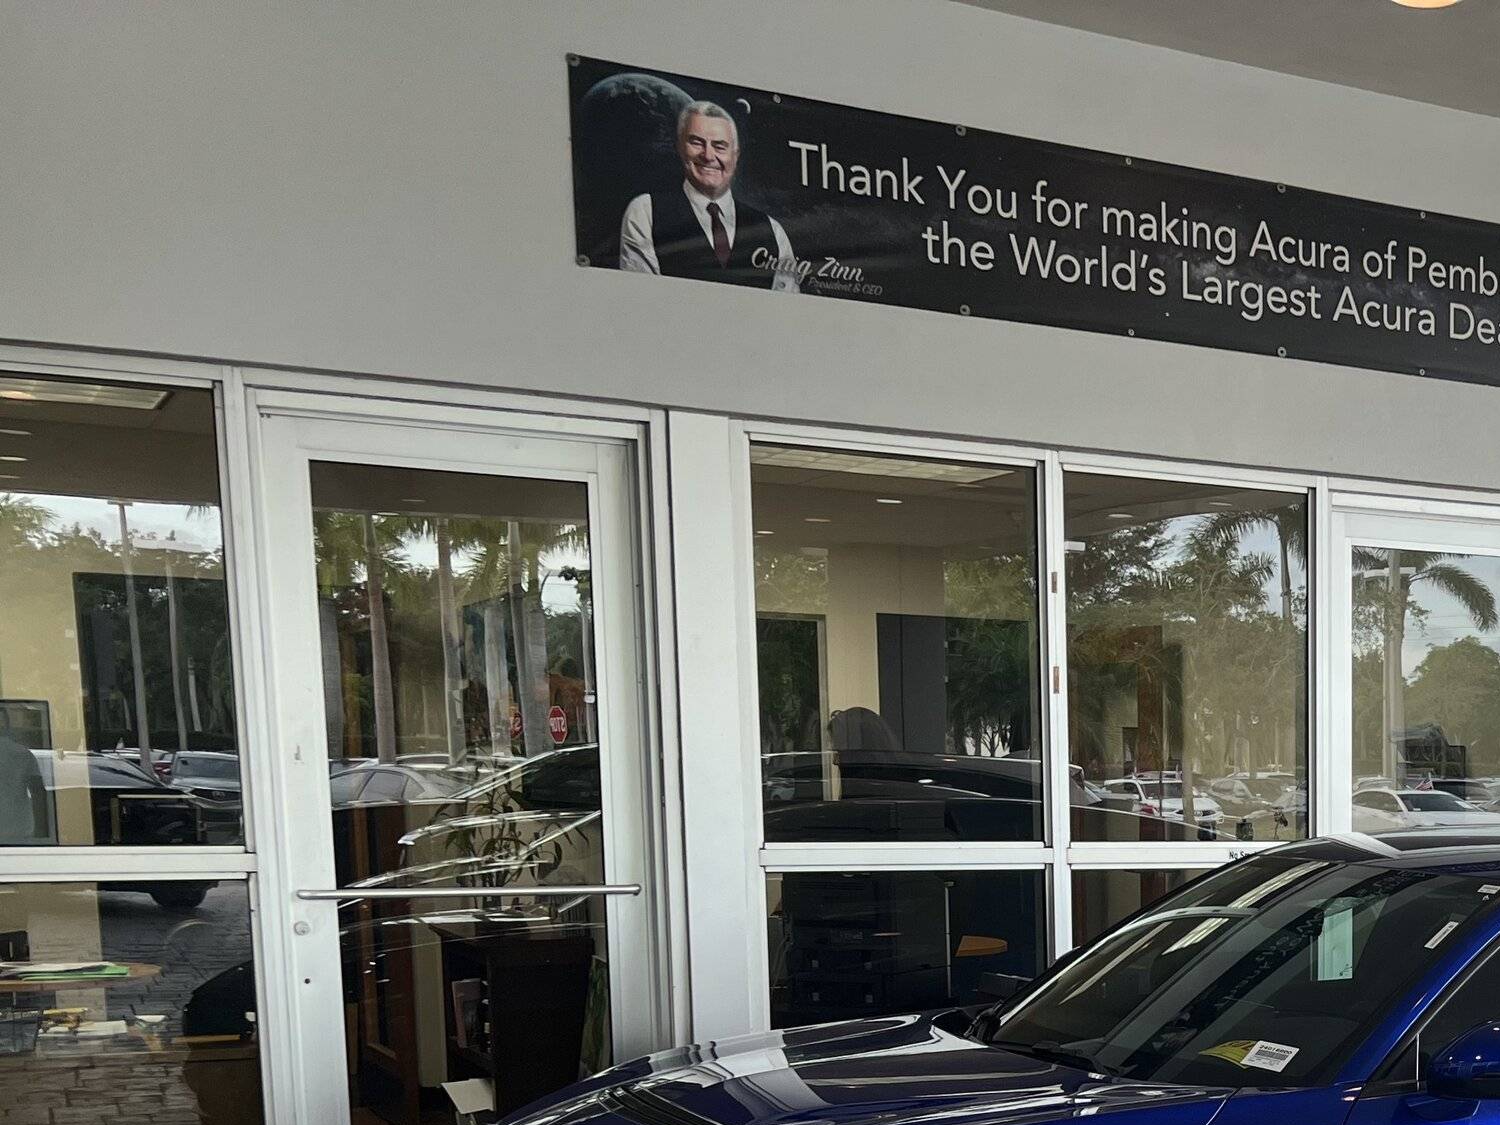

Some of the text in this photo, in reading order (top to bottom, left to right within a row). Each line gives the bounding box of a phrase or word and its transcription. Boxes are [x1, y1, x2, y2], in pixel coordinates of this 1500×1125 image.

[788, 140, 925, 205] Thank
[936, 165, 1019, 220] You
[1031, 180, 1089, 229] for
[1102, 202, 1237, 265] making
[1249, 220, 1351, 273] Acura
[1363, 240, 1398, 280] of
[751, 247, 864, 285] Craig Zinn
[862, 284, 883, 296] CEO
[921, 220, 995, 271] the
[1008, 233, 1168, 296] World's
[1182, 260, 1322, 321] Largest
[1332, 285, 1436, 336] Acura
